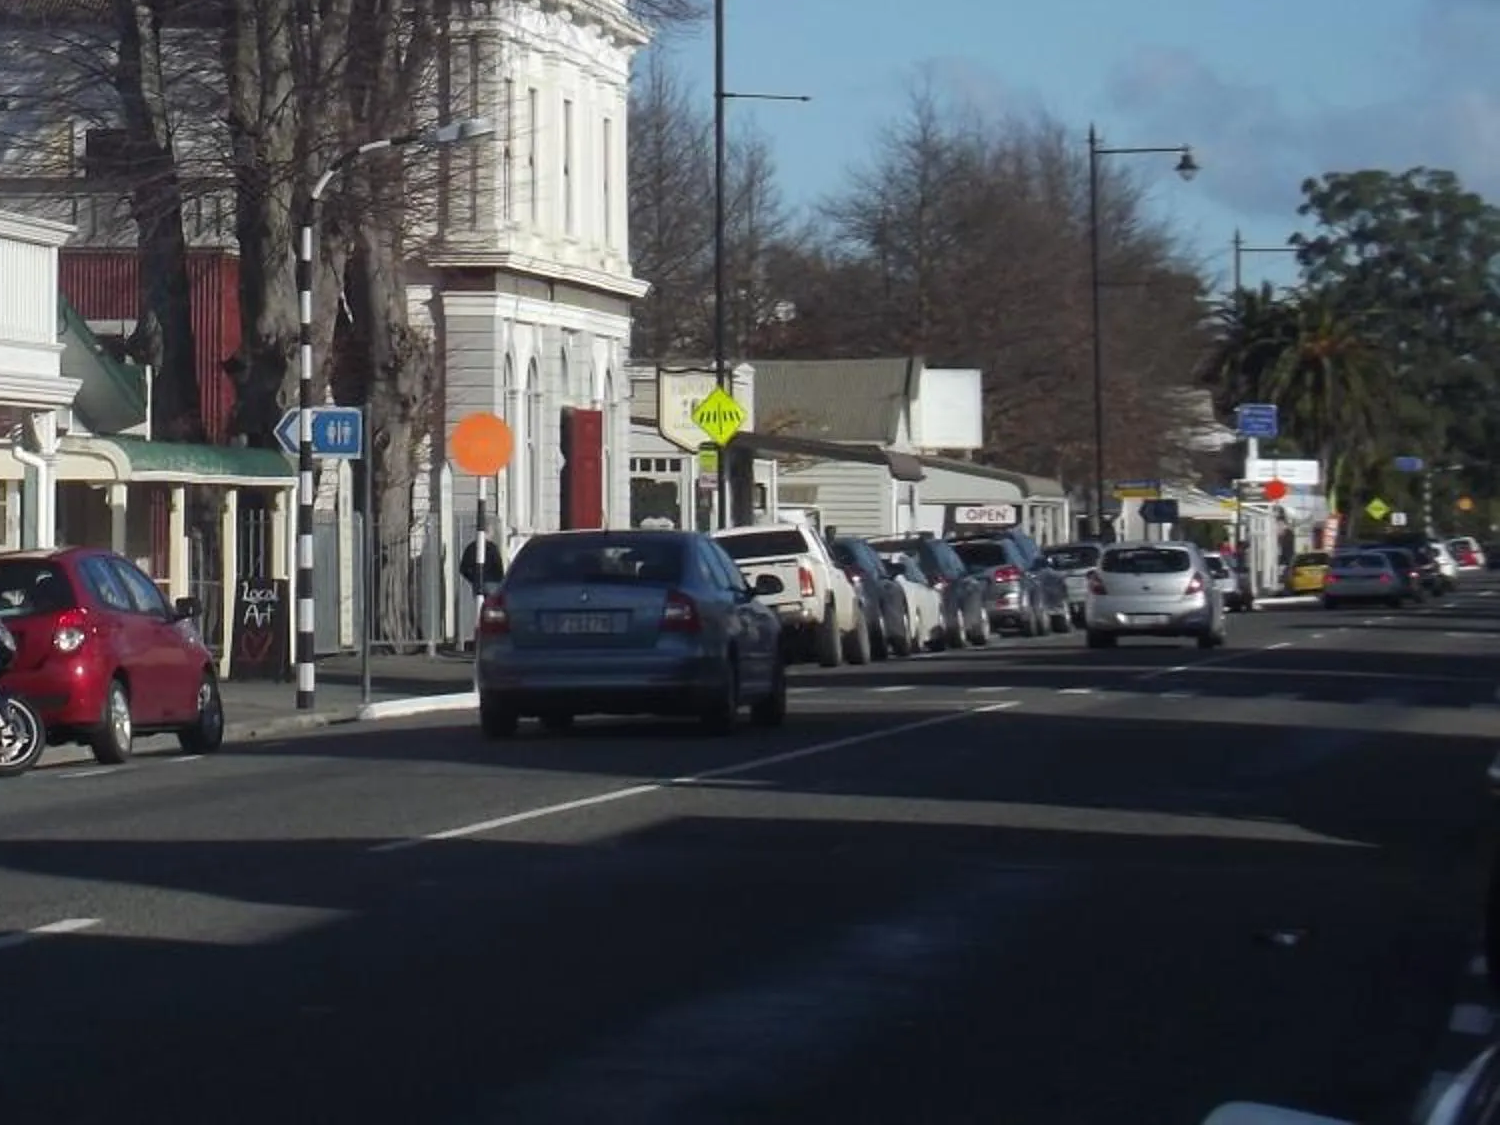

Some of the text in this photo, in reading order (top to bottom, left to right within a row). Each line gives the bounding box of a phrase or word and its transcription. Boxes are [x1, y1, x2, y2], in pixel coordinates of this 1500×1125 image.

[966, 508, 1008, 521] OPEN
[241, 581, 279, 603] Local
[243, 604, 276, 627] Art
